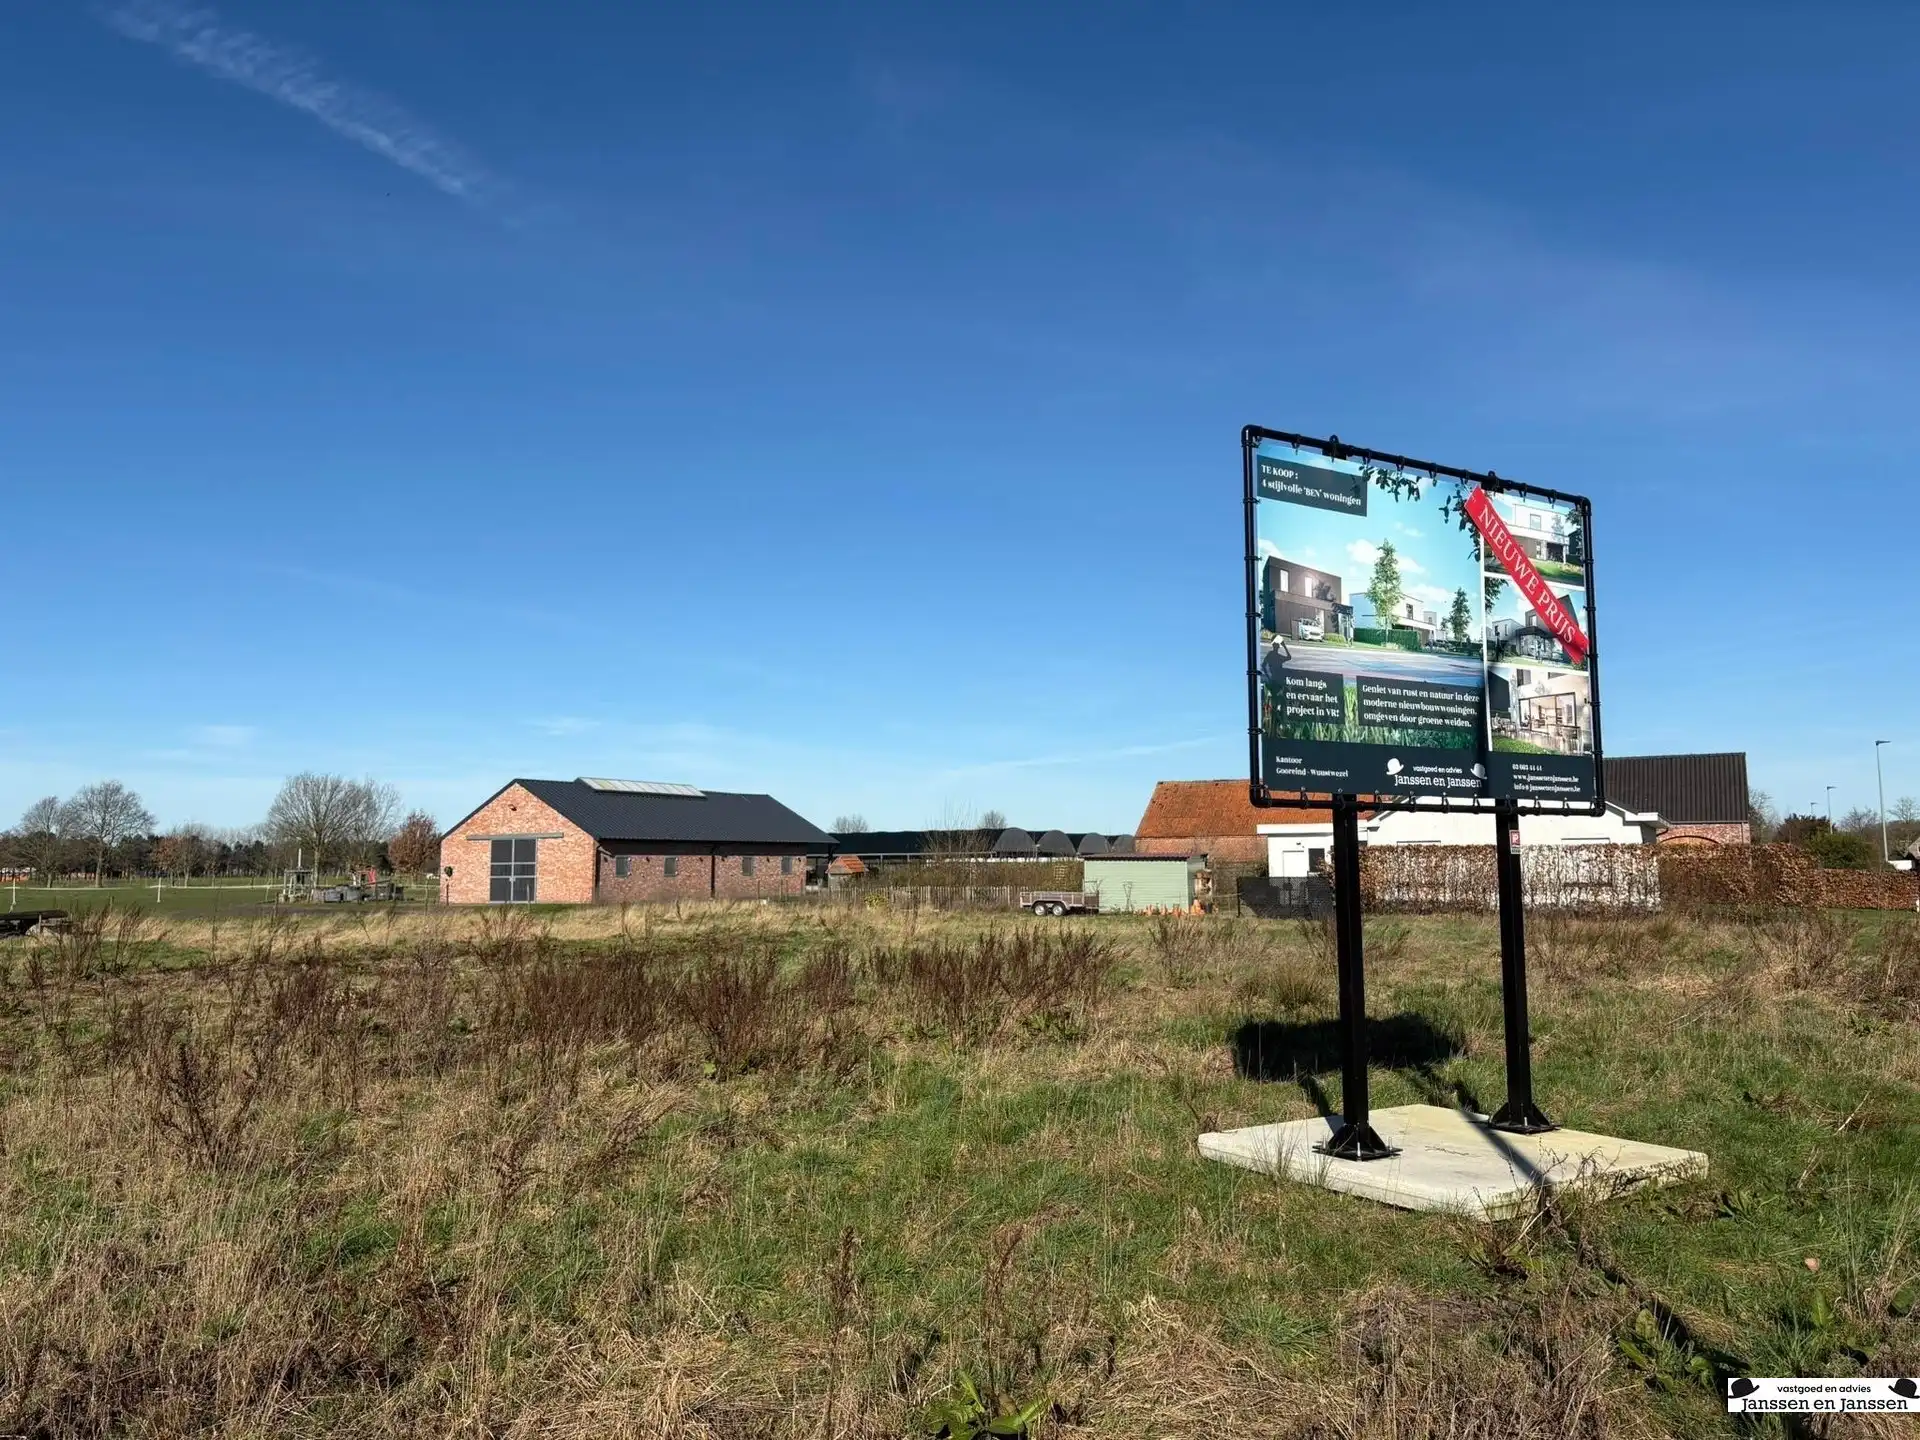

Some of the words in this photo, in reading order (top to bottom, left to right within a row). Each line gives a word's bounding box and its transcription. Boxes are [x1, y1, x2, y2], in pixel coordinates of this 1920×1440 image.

[1261, 465, 1272, 474] TE
[1272, 468, 1294, 478] KOOP
[1268, 481, 1302, 494] stijlvolle
[1323, 492, 1362, 506] woningen
[1478, 505, 1540, 596] NIEUWE
[1538, 591, 1576, 644] PRIJS
[1286, 676, 1304, 686] Kom
[1305, 678, 1328, 690] langs
[1286, 692, 1296, 700] en
[1298, 693, 1324, 702] ervaar
[1325, 694, 1338, 704] het
[1362, 684, 1386, 694] Geniet
[1387, 687, 1402, 696] van
[1402, 688, 1418, 698] rust
[1419, 690, 1428, 698] en
[1430, 690, 1454, 700] natuur
[1456, 692, 1462, 701] in
[1464, 692, 1480, 702] deze
[1364, 698, 1398, 709] moderne
[1286, 704, 1315, 718] project
[1316, 707, 1324, 716] in
[1326, 708, 1340, 718] VR!
[1364, 712, 1398, 722] omgeven
[1400, 713, 1418, 723] door
[1418, 716, 1444, 726] groene
[1444, 717, 1472, 728] weiden.
[1276, 756, 1302, 764] Kantoor
[1276, 767, 1306, 776] Gooreind
[1413, 766, 1438, 774] vastgoed
[1446, 766, 1462, 774] advies
[1395, 774, 1432, 787] Janssen
[1433, 778, 1446, 787] en
[1447, 776, 1482, 788] Janssen
